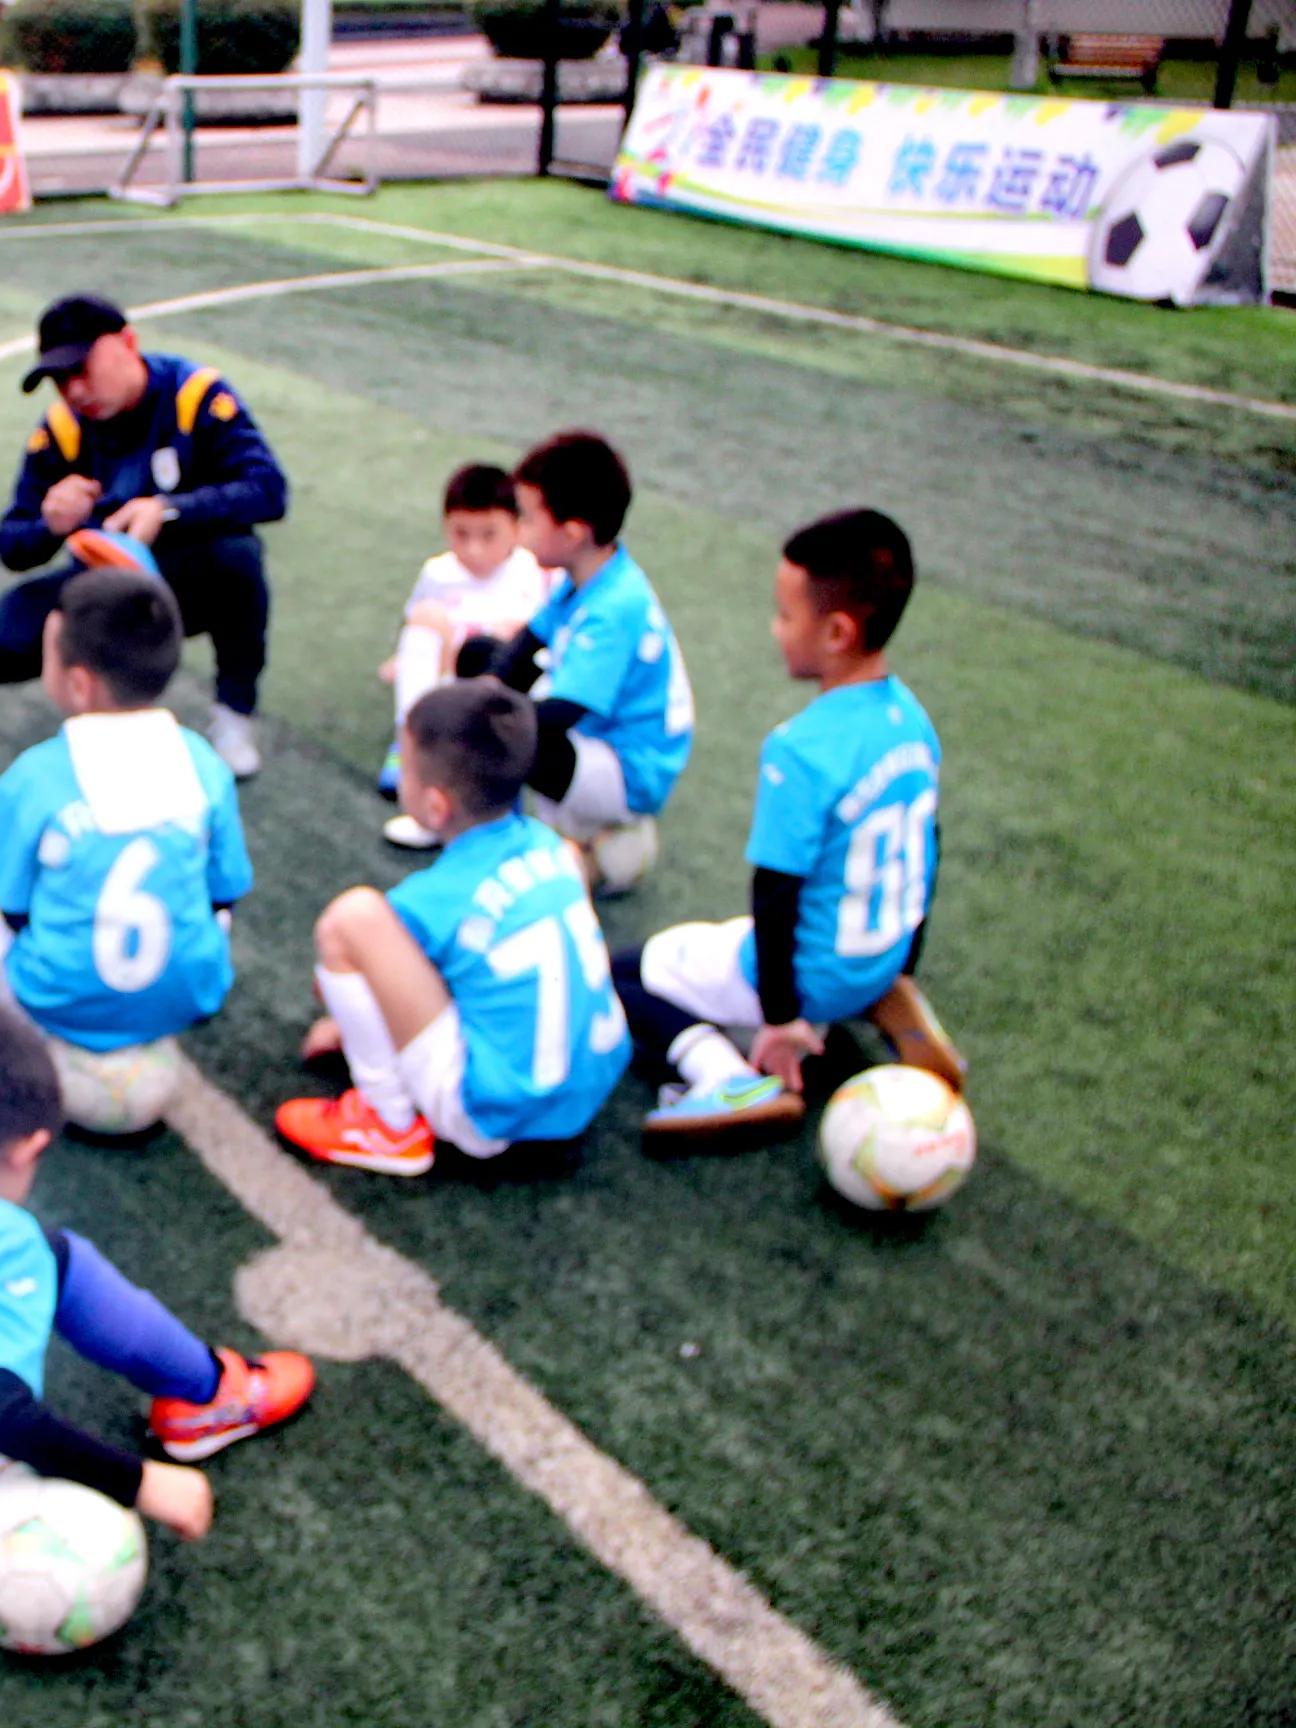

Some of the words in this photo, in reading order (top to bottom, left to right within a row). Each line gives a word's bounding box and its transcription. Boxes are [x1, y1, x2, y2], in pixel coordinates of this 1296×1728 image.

[696, 112, 862, 187] 全民健身
[885, 133, 1100, 220] 快乐运动
[92, 837, 171, 993] 6
